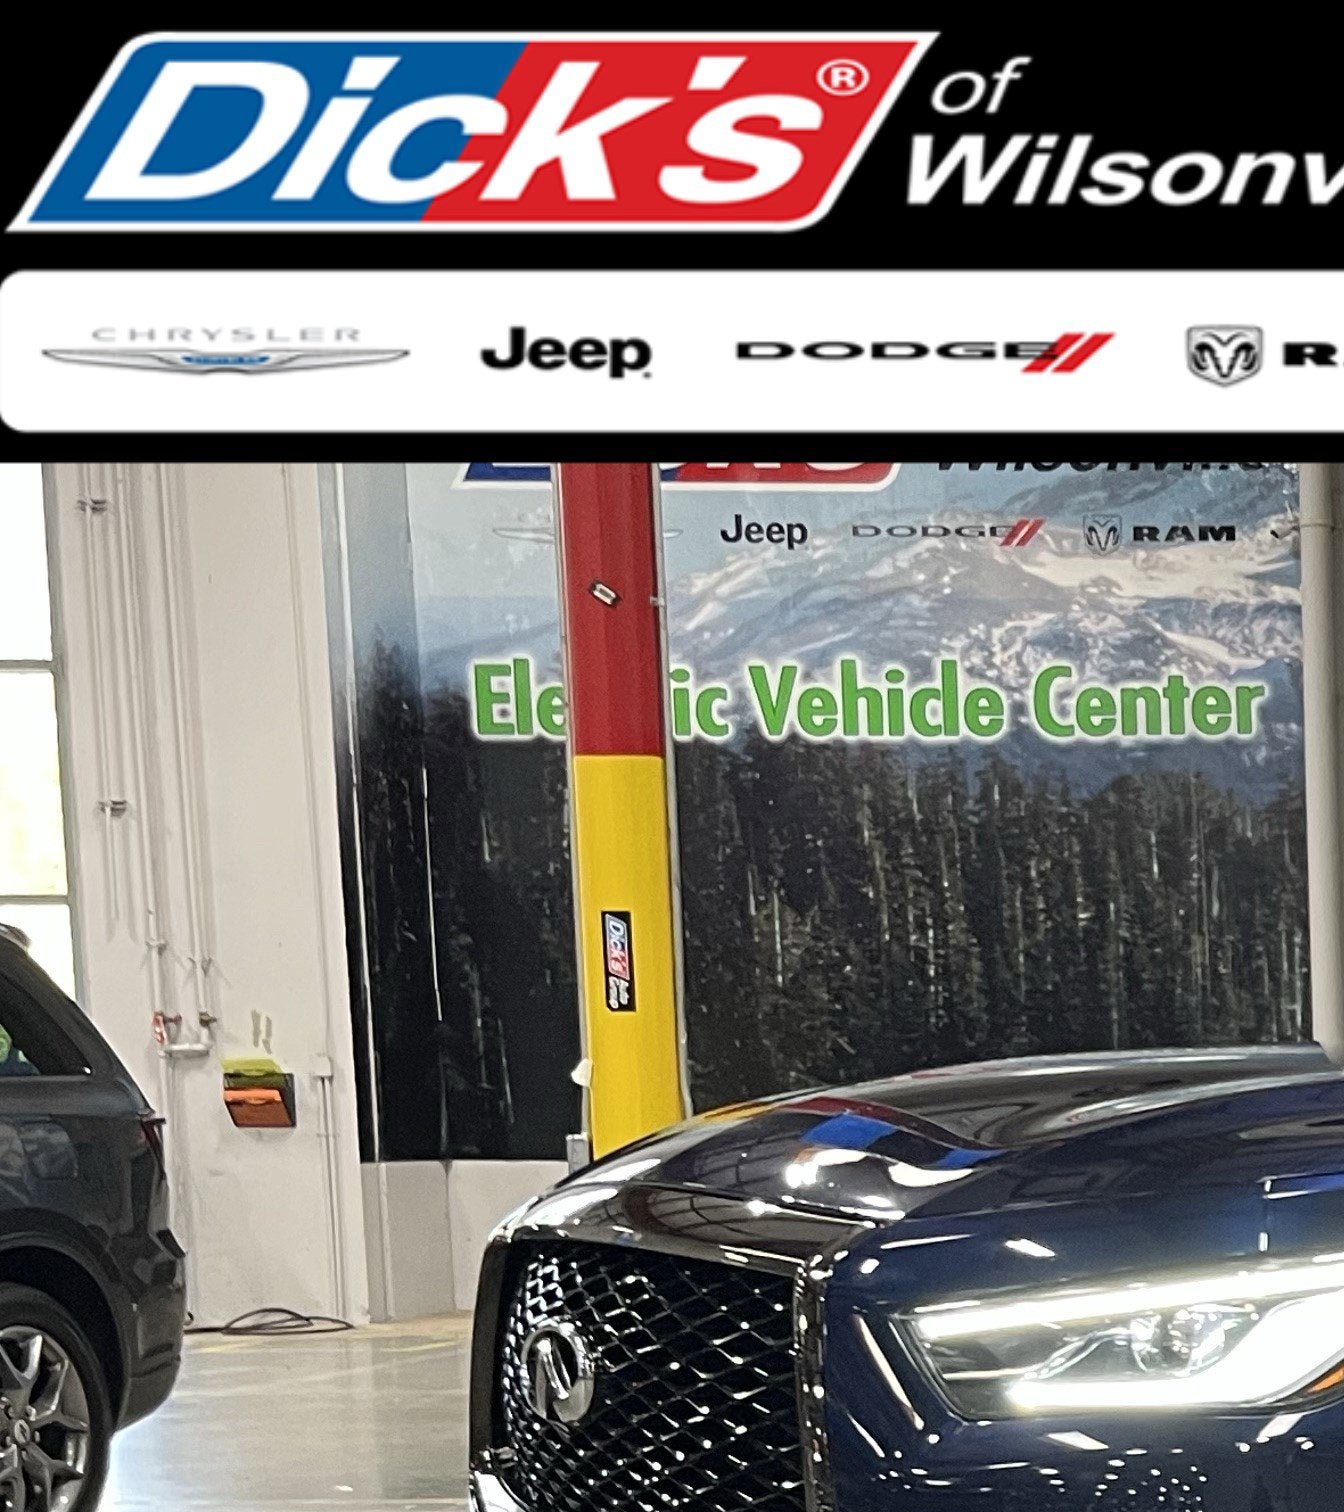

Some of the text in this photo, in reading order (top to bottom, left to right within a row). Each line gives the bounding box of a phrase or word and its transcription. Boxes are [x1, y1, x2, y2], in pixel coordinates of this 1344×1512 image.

[720, 513, 809, 550] Jeep
[851, 523, 1013, 539] DODGE
[1132, 525, 1237, 542] RAM
[473, 658, 1266, 738] Eleic Vehicle Center
